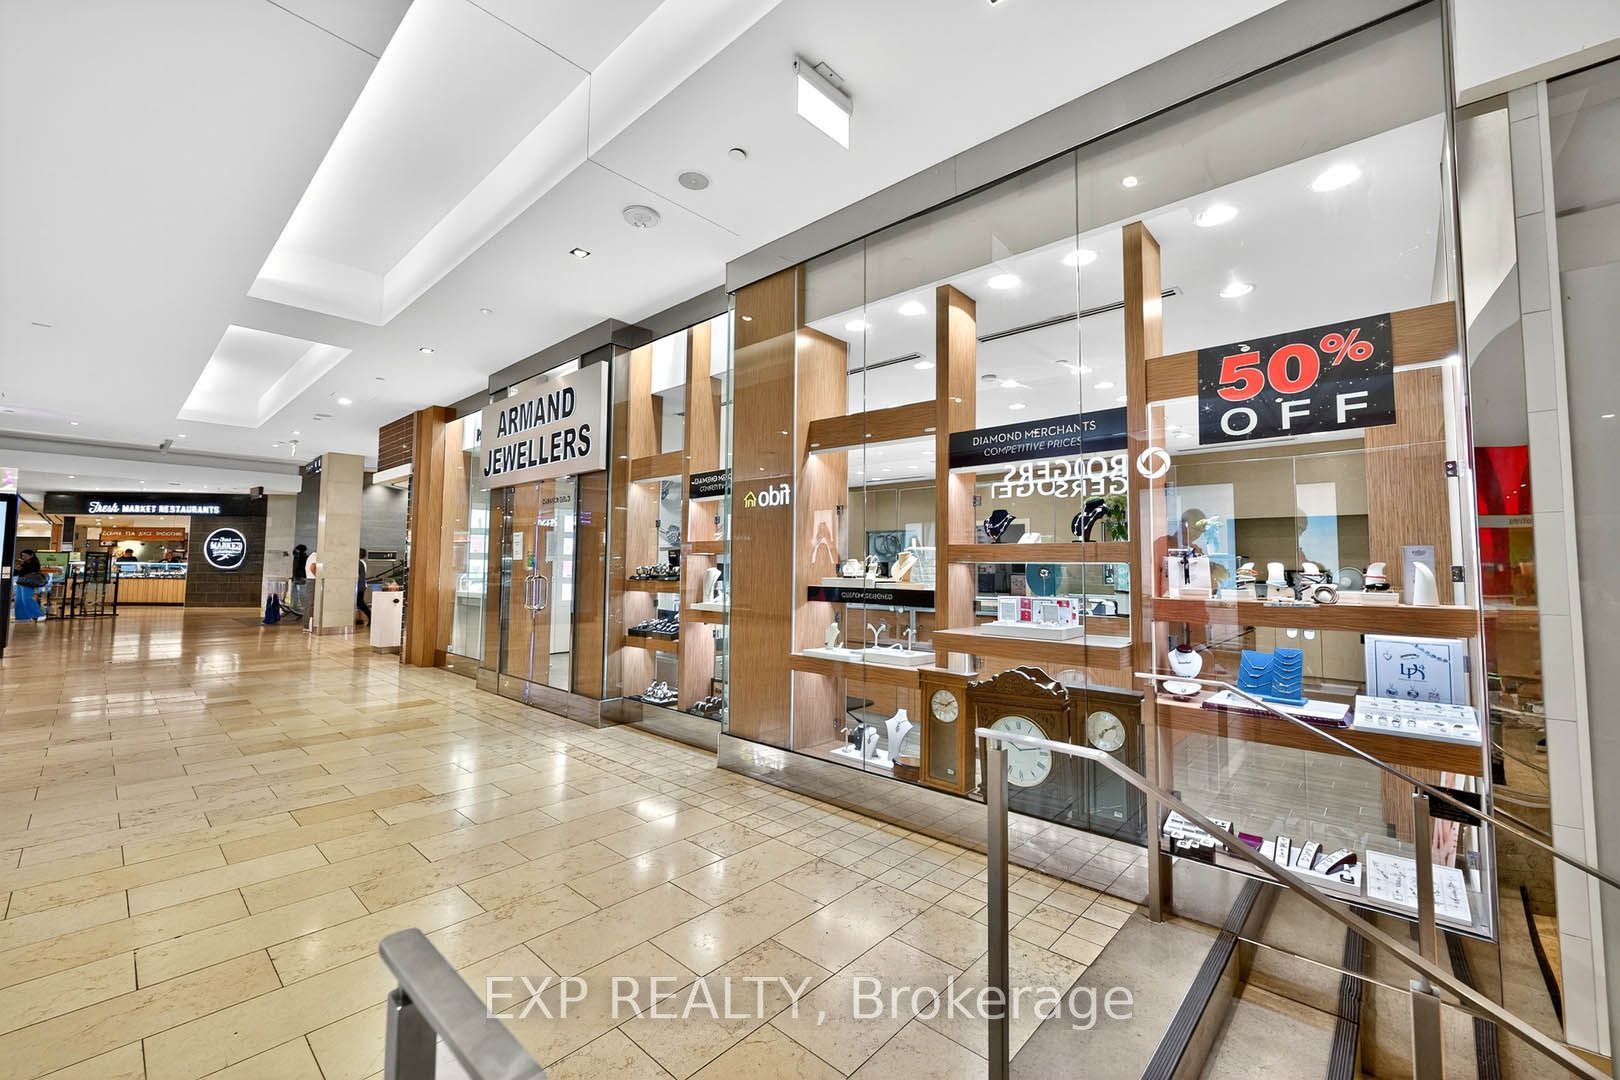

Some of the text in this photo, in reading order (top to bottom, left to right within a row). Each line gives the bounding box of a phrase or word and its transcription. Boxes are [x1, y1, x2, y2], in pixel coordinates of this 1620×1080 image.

[1217, 328, 1374, 401] 50%
[497, 386, 576, 438] ARMAND
[972, 420, 1097, 446] DIAMOND MERCHANTS
[1220, 391, 1369, 436] OFF
[484, 423, 591, 477] JEWELLERS
[983, 436, 1082, 457] COMPETITIVE PRICES
[88, 501, 221, 514] Fresh MARKET RESTAURANTS
